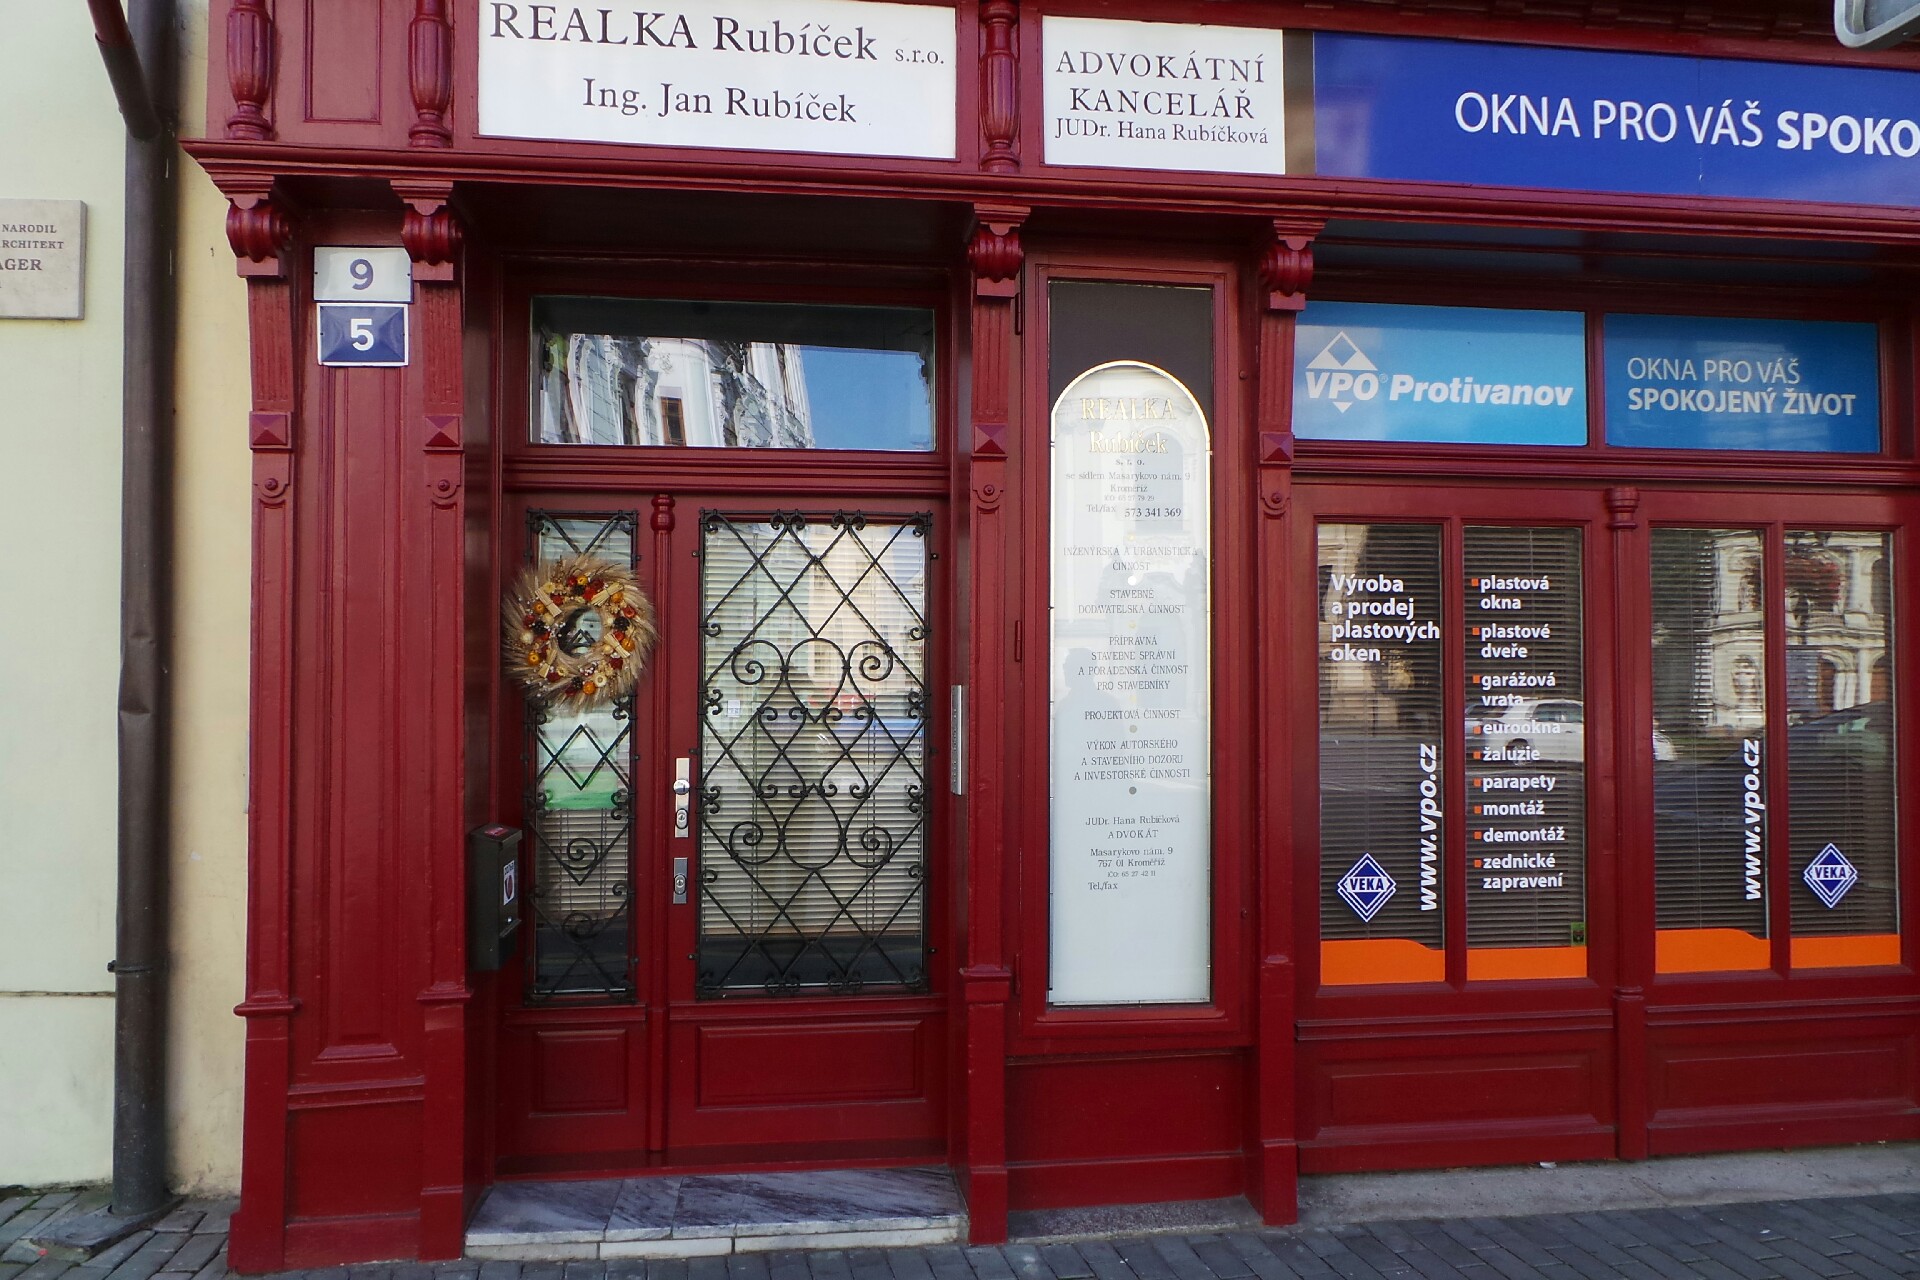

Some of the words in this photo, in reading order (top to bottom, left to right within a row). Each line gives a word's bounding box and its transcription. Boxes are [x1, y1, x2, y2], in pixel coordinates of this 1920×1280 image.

[490, 3, 698, 49] REALKA
[712, 16, 878, 61] Rubíček
[894, 46, 945, 65] s.r.o.
[1056, 50, 1265, 83] ADVOKÁTNÍ
[583, 78, 647, 116] Ing.
[658, 83, 712, 117] Jan
[725, 87, 857, 123] Rubíček
[1070, 88, 1255, 119] KANCELÁŘ
[1055, 118, 1110, 138] JUDr.
[1118, 121, 1166, 140] Hana
[1172, 124, 1268, 144] Rubíčková
[1454, 92, 1580, 138] OKNA
[1593, 100, 1677, 143] PRO
[1686, 98, 1764, 147] VÁŠ
[1777, 110, 1920, 158] SPOKO
[2, 224, 57, 234] NARODIL
[0, 240, 64, 249] RCHITEKT
[350, 258, 374, 290] 9
[350, 318, 374, 350] 5
[1628, 358, 1697, 381] OKNA
[1704, 360, 1751, 383] PRO
[1756, 358, 1800, 384] VÁŠ
[1390, 374, 1574, 406] Protivanov
[1628, 387, 1776, 414] SPOKOJENÝ
[1782, 386, 1856, 416] ŽIVOT
[1080, 398, 1176, 420] REALKA
[1089, 430, 1169, 454] Rubíček
[1108, 471, 1158, 482] Masarykovo
[1161, 472, 1182, 480] nám.
[1184, 472, 1191, 480] 9
[1124, 508, 1142, 518] 573
[1144, 508, 1160, 518] 341
[1164, 508, 1182, 518] 369
[1112, 560, 1150, 570] ČINNOST
[1331, 574, 1404, 596] Výroba
[1481, 575, 1550, 592] plastová
[1148, 603, 1186, 614] ČINNOST
[1332, 602, 1342, 614] a
[1348, 598, 1414, 620] prodej
[1481, 595, 1522, 609] okna
[1332, 620, 1440, 644] plastových
[1482, 623, 1550, 641] plastové
[1109, 635, 1158, 646] PŘÍPRAVNÁ
[1140, 649, 1176, 660] SPRÁVNÍ
[1332, 643, 1380, 661] oken
[1481, 643, 1528, 658] dveře
[1078, 667, 1084, 676] A
[1151, 664, 1188, 674] ČINNOST
[1097, 682, 1114, 690] PRO
[1118, 679, 1170, 690] STAVEBNÍKY
[1482, 672, 1556, 690] garážová
[1482, 694, 1524, 706] vrata
[1084, 709, 1140, 720] PROJEKTOVÁ
[1144, 708, 1181, 719] ČINNOST
[1483, 720, 1560, 734] eurookna
[1086, 739, 1116, 750] VÝKON
[1120, 738, 1178, 750] AUTORSKÉHO
[1082, 757, 1087, 766] A
[1092, 754, 1144, 766] STAVEBNÍHO
[1148, 755, 1183, 764] DOZORU
[1483, 746, 1540, 760] žaluzie
[1074, 772, 1080, 780] A
[1084, 768, 1146, 780] INVESTORSKÉ
[1150, 768, 1190, 778] ČINNOSTI
[1483, 775, 1556, 792] parapety
[1483, 800, 1545, 815] montáž
[1086, 817, 1110, 826] JUDr.
[1114, 816, 1136, 824] Hana
[1744, 739, 1765, 900] www.vpo.cz
[1108, 828, 1158, 839] ADVOKÁT
[1420, 744, 1442, 911] www.vpo.cz
[1483, 826, 1565, 842] demontáž
[1090, 848, 1140, 858] Masarykovo
[1144, 848, 1164, 856] nám.
[1168, 847, 1174, 855] 9
[1098, 860, 1112, 868] 767
[1128, 858, 1166, 866] Kroměříž
[1483, 853, 1556, 868] zednické
[1814, 866, 1846, 878] VEKA
[1350, 878, 1384, 891] VEKA
[1483, 873, 1563, 892] zapravení
